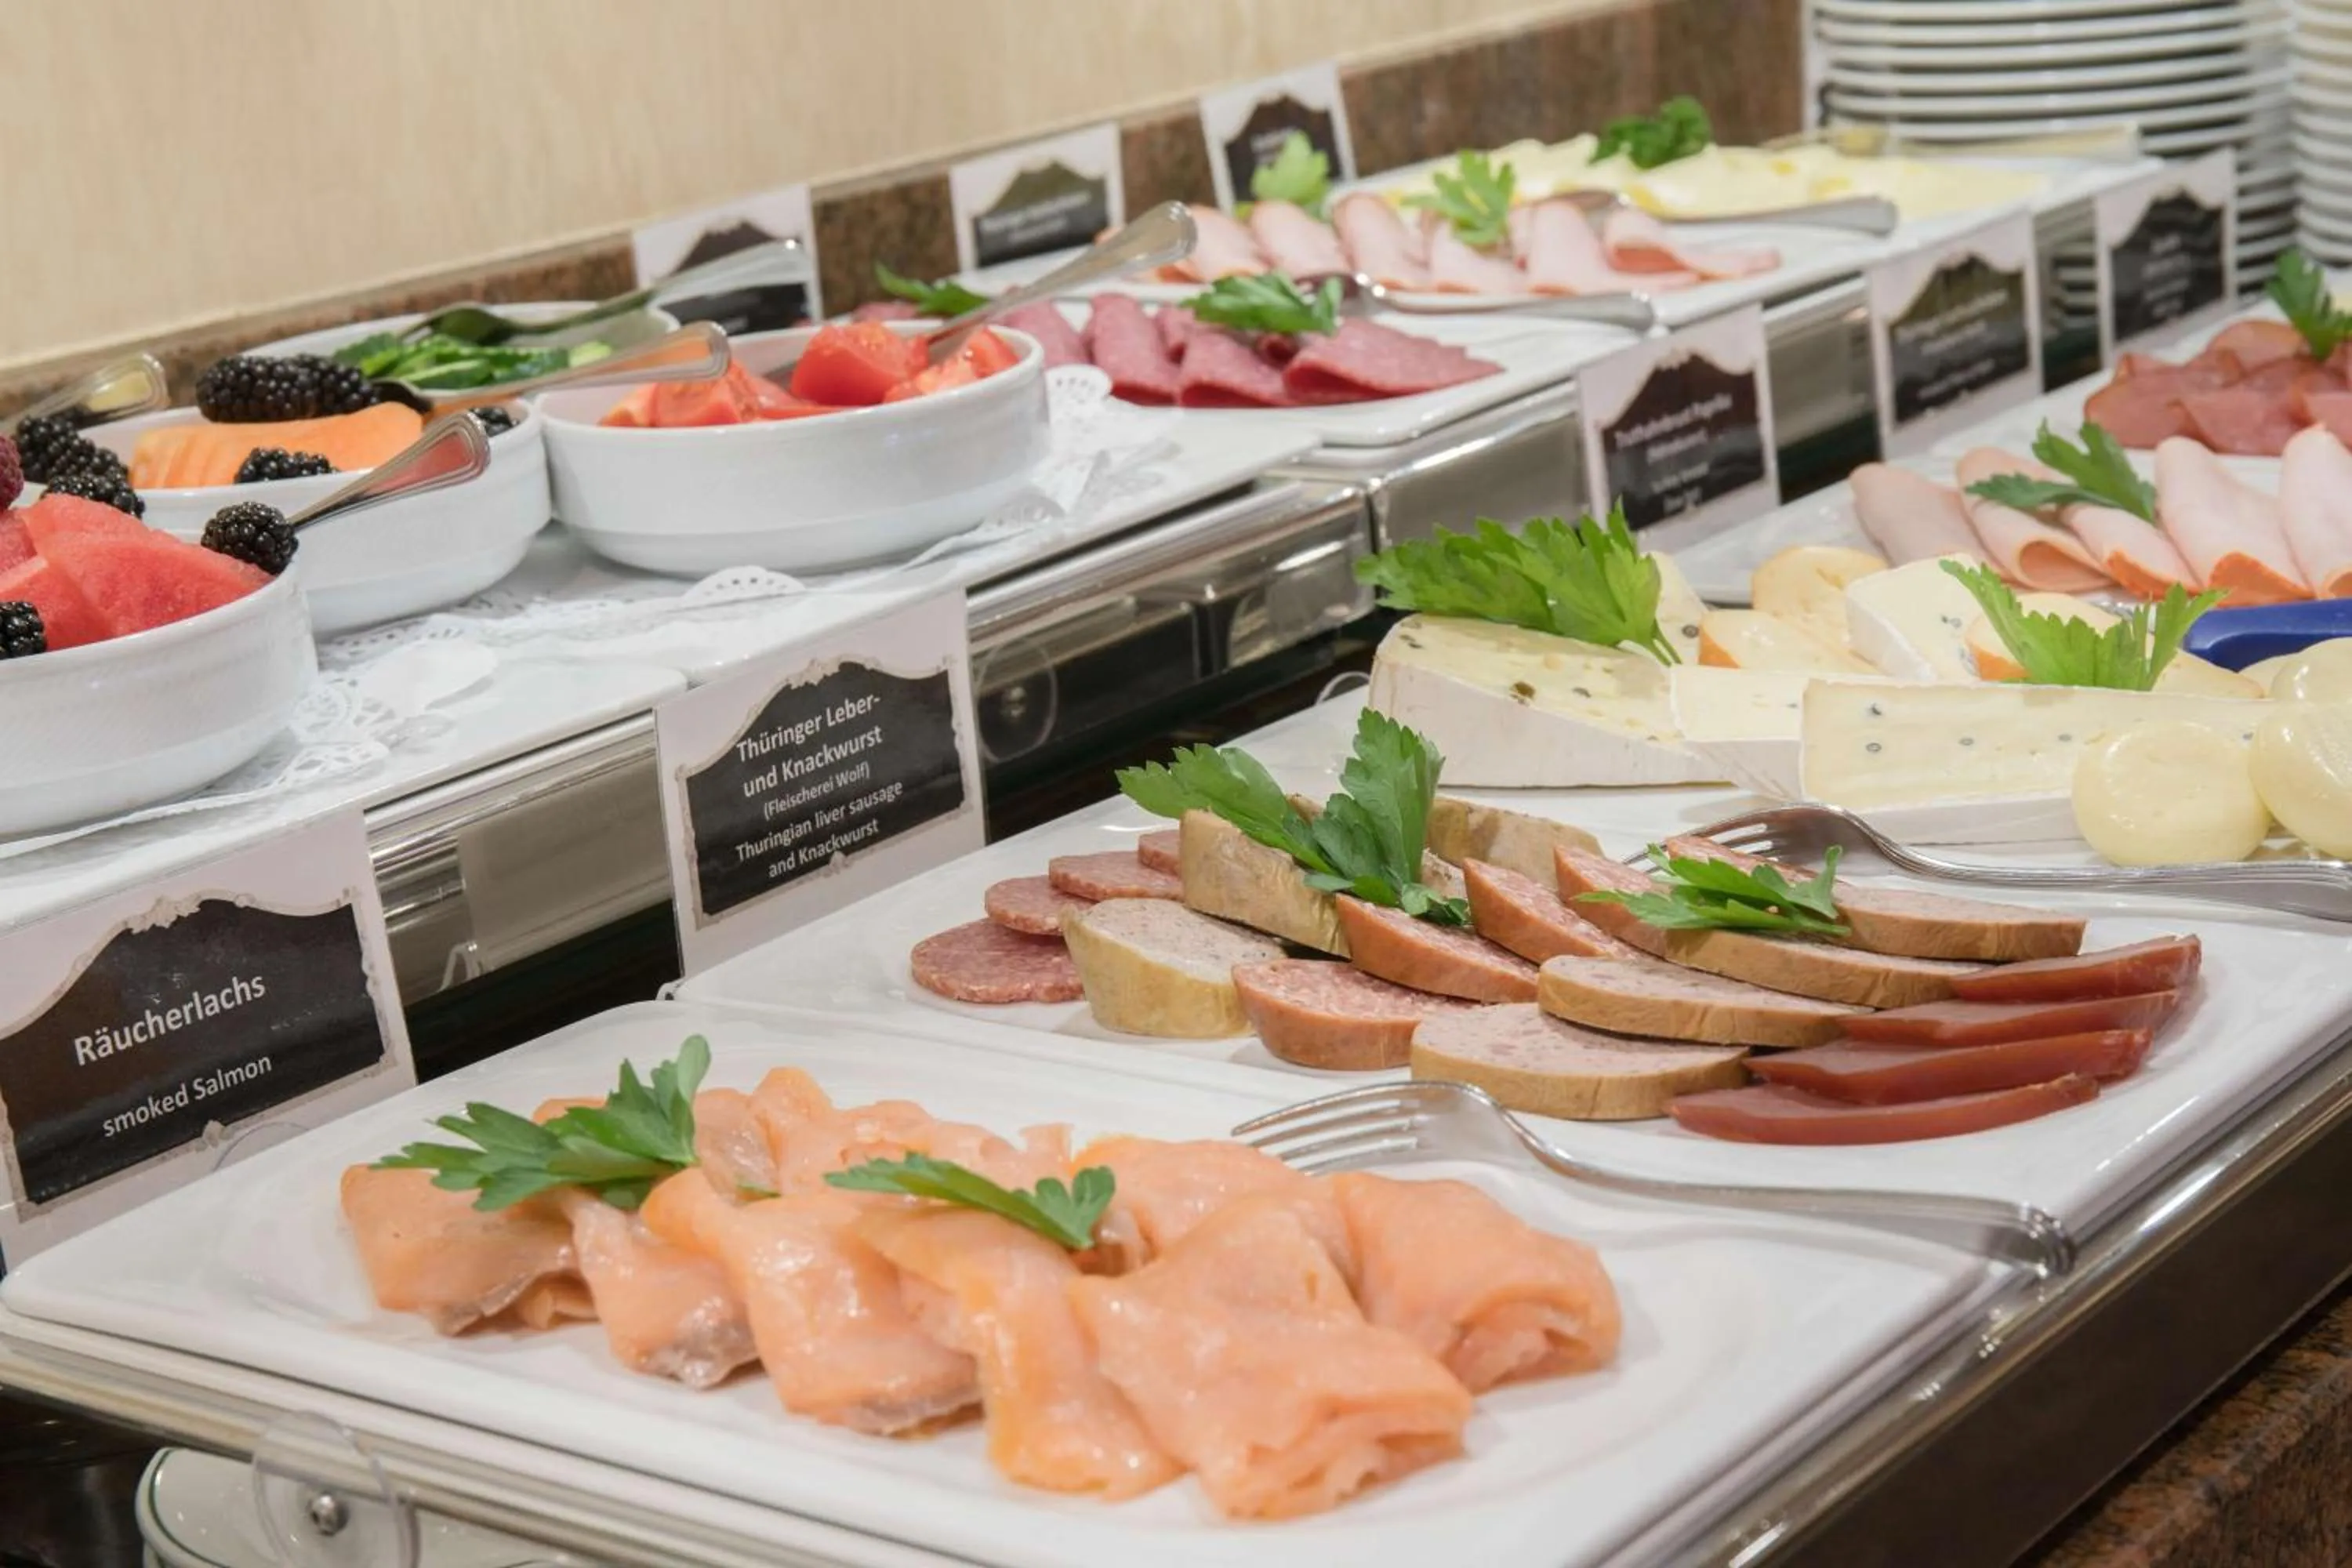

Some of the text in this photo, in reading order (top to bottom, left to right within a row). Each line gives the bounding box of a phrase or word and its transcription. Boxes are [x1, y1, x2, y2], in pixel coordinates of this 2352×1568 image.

[736, 694, 880, 762] Thüringer Leber-
[743, 726, 884, 797] und Knackwurst
[735, 782, 903, 862] Thuringian liver sausage
[764, 761, 870, 820] (Fleischerei Wolf)
[768, 819, 879, 878] and Knackwurst
[74, 976, 266, 1065] Räucherlachs
[103, 1055, 272, 1138] smoked Salmon
